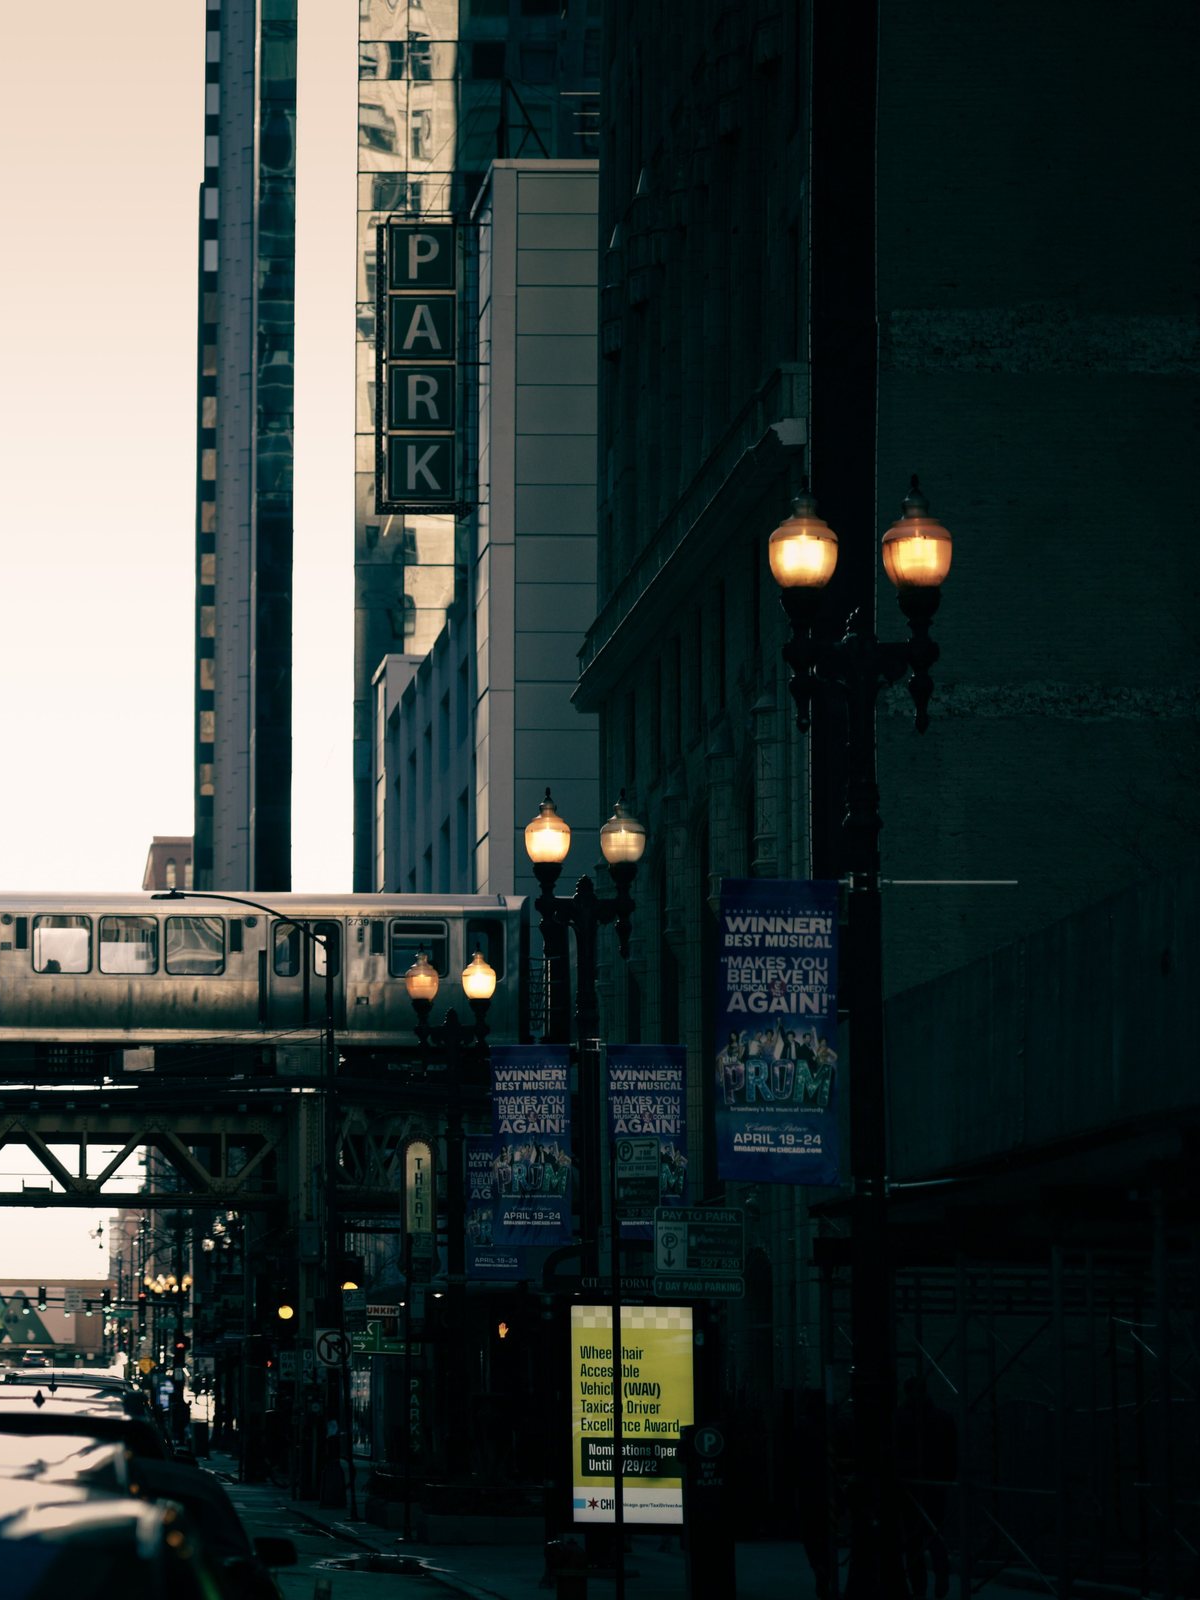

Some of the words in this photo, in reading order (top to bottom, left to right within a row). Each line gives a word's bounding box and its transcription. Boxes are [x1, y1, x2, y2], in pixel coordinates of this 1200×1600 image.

[402, 233, 442, 491] PARK
[348, 918, 369, 926] 2739
[724, 916, 832, 934] WINNER!
[724, 933, 762, 947] BEST
[765, 934, 832, 948] MUSICAL
[790, 956, 829, 970] YOU
[727, 969, 804, 984] BELIEVE
[809, 970, 829, 985] IN
[727, 984, 769, 992] MUSICAL
[785, 984, 829, 993] COMEDY
[495, 1069, 567, 1081] WINNER!
[609, 1069, 683, 1081] WINNER!
[495, 1081, 521, 1091] BEST
[522, 1081, 567, 1090] MUSICAL
[610, 1081, 636, 1090] BEST
[637, 1081, 682, 1090] MUSICAL
[723, 1059, 832, 1106] PROM
[540, 1096, 565, 1105] YOU
[655, 1096, 680, 1105] YOU
[498, 1104, 549, 1114] BELIEVE
[552, 1104, 565, 1114] IN
[613, 1104, 665, 1114] BELIEVE
[667, 1105, 681, 1114] IN
[733, 1133, 774, 1145] APRIL
[497, 1163, 568, 1193] PROM
[414, 1158, 424, 1229] THEAT
[503, 1212, 530, 1220] APRIL
[662, 1210, 683, 1220] PAY
[686, 1210, 703, 1221] TO
[705, 1211, 737, 1222] PARK
[474, 1256, 496, 1264] APRIL
[657, 1281, 663, 1290] 7
[665, 1282, 681, 1290] DAY
[683, 1282, 703, 1291] PAID
[704, 1282, 741, 1292] PARKING
[366, 1306, 399, 1314] UNKIN'
[580, 1345, 644, 1360] Wheehair
[580, 1381, 614, 1396] Vehicl
[624, 1382, 661, 1399] (WAV)
[627, 1400, 662, 1414] Driver
[581, 1417, 641, 1432] Excellnce
[644, 1418, 680, 1432] Award
[588, 1443, 651, 1456] Nomiations
[588, 1459, 612, 1472] Until
[621, 1459, 658, 1475] /29/22
